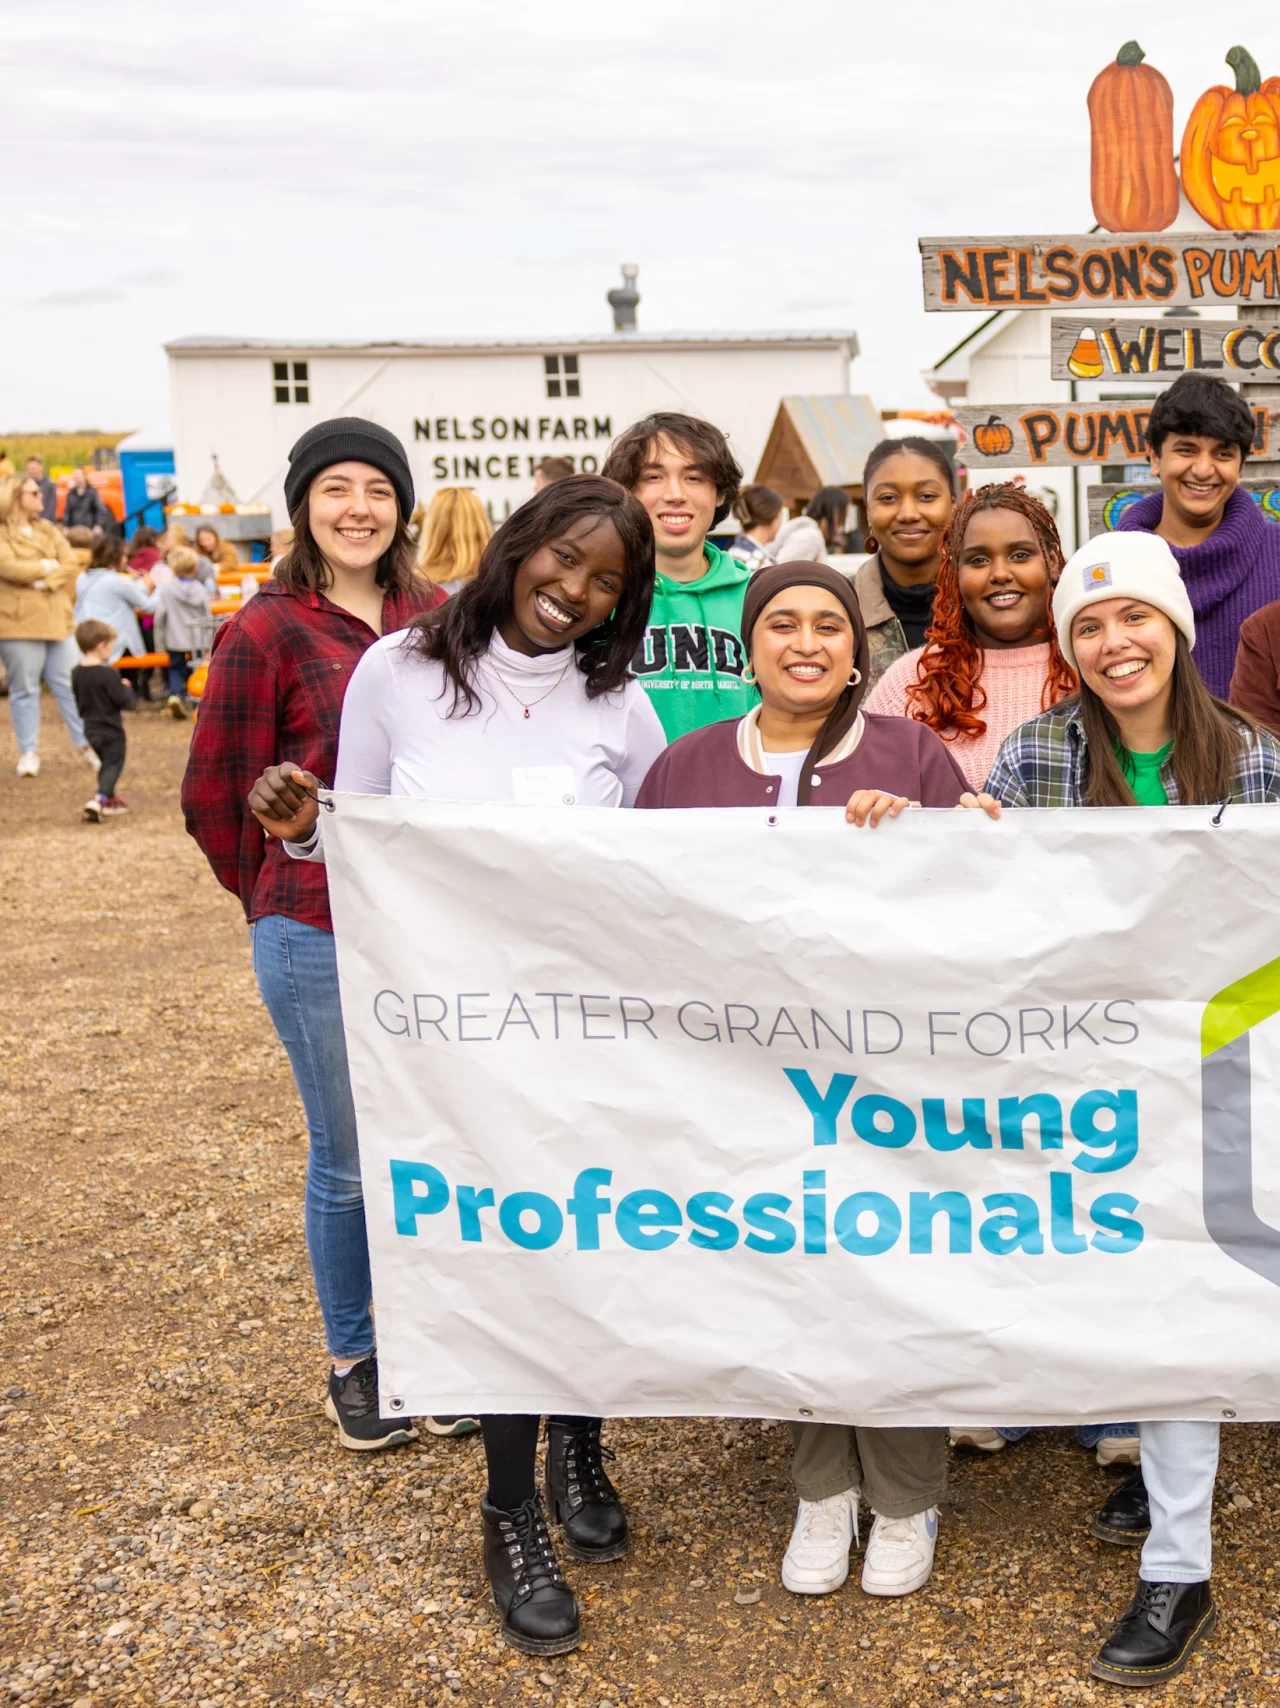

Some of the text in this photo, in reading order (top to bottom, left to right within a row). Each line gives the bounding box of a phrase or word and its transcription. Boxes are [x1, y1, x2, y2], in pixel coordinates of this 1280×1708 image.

[938, 241, 1177, 304] NELSON'S
[414, 416, 612, 440] NELSON FARM
[434, 455, 597, 479] SINCE 10
[629, 623, 745, 677] UND
[373, 989, 1140, 1057] GREATER GRAND FORKS
[781, 1068, 1138, 1173] Young
[390, 1159, 1145, 1256] Professionals
